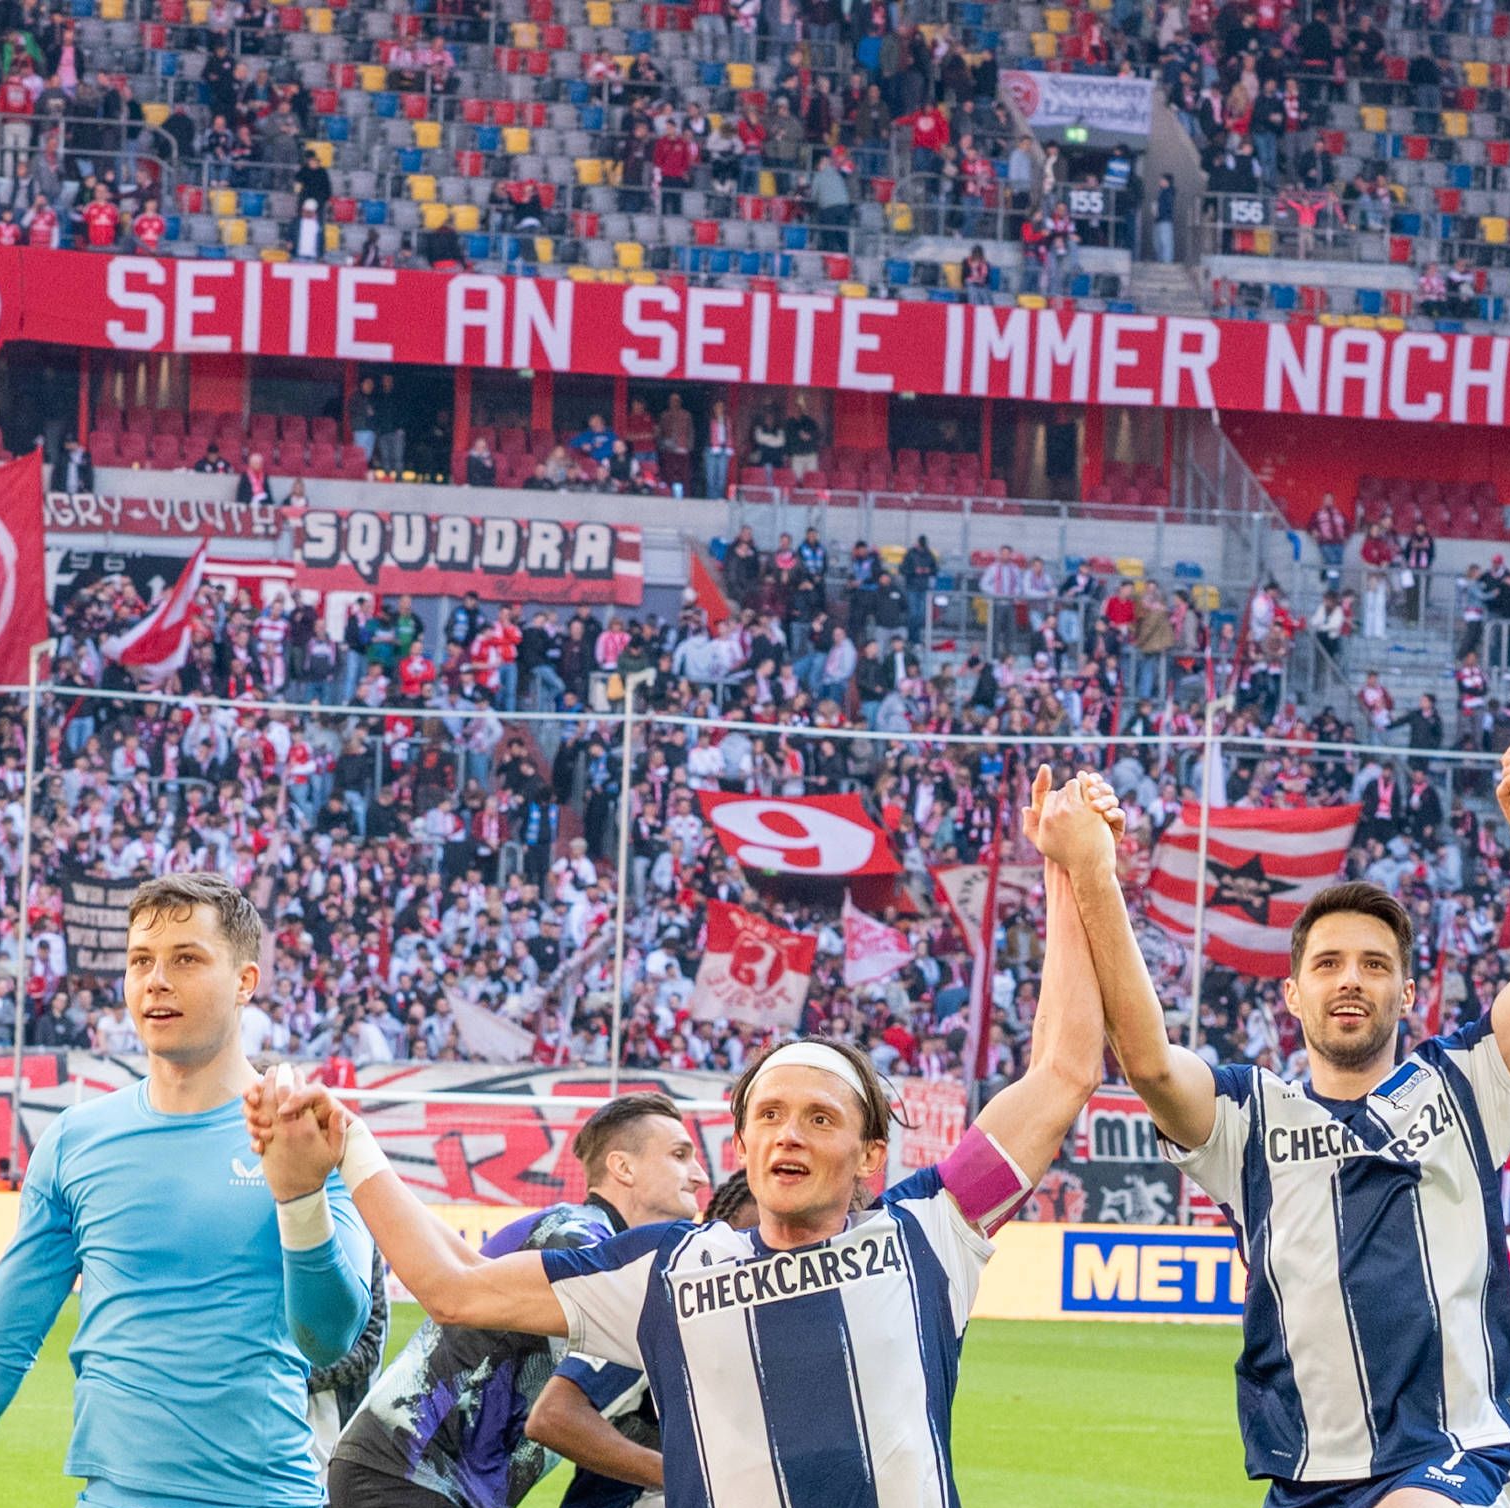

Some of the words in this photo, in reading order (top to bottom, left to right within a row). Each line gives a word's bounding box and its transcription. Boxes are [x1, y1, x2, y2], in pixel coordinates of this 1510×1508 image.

[1070, 190, 1104, 214] 155
[1229, 201, 1264, 224] 156
[107, 256, 396, 361] SEITE
[446, 274, 574, 373] AN
[622, 284, 898, 392] SEITE
[944, 304, 1220, 408] IMMER
[1264, 321, 1509, 424] NACH
[301, 510, 615, 585] SQUADRA
[710, 801, 875, 875] 9
[678, 1235, 903, 1319] CHECKCARS24
